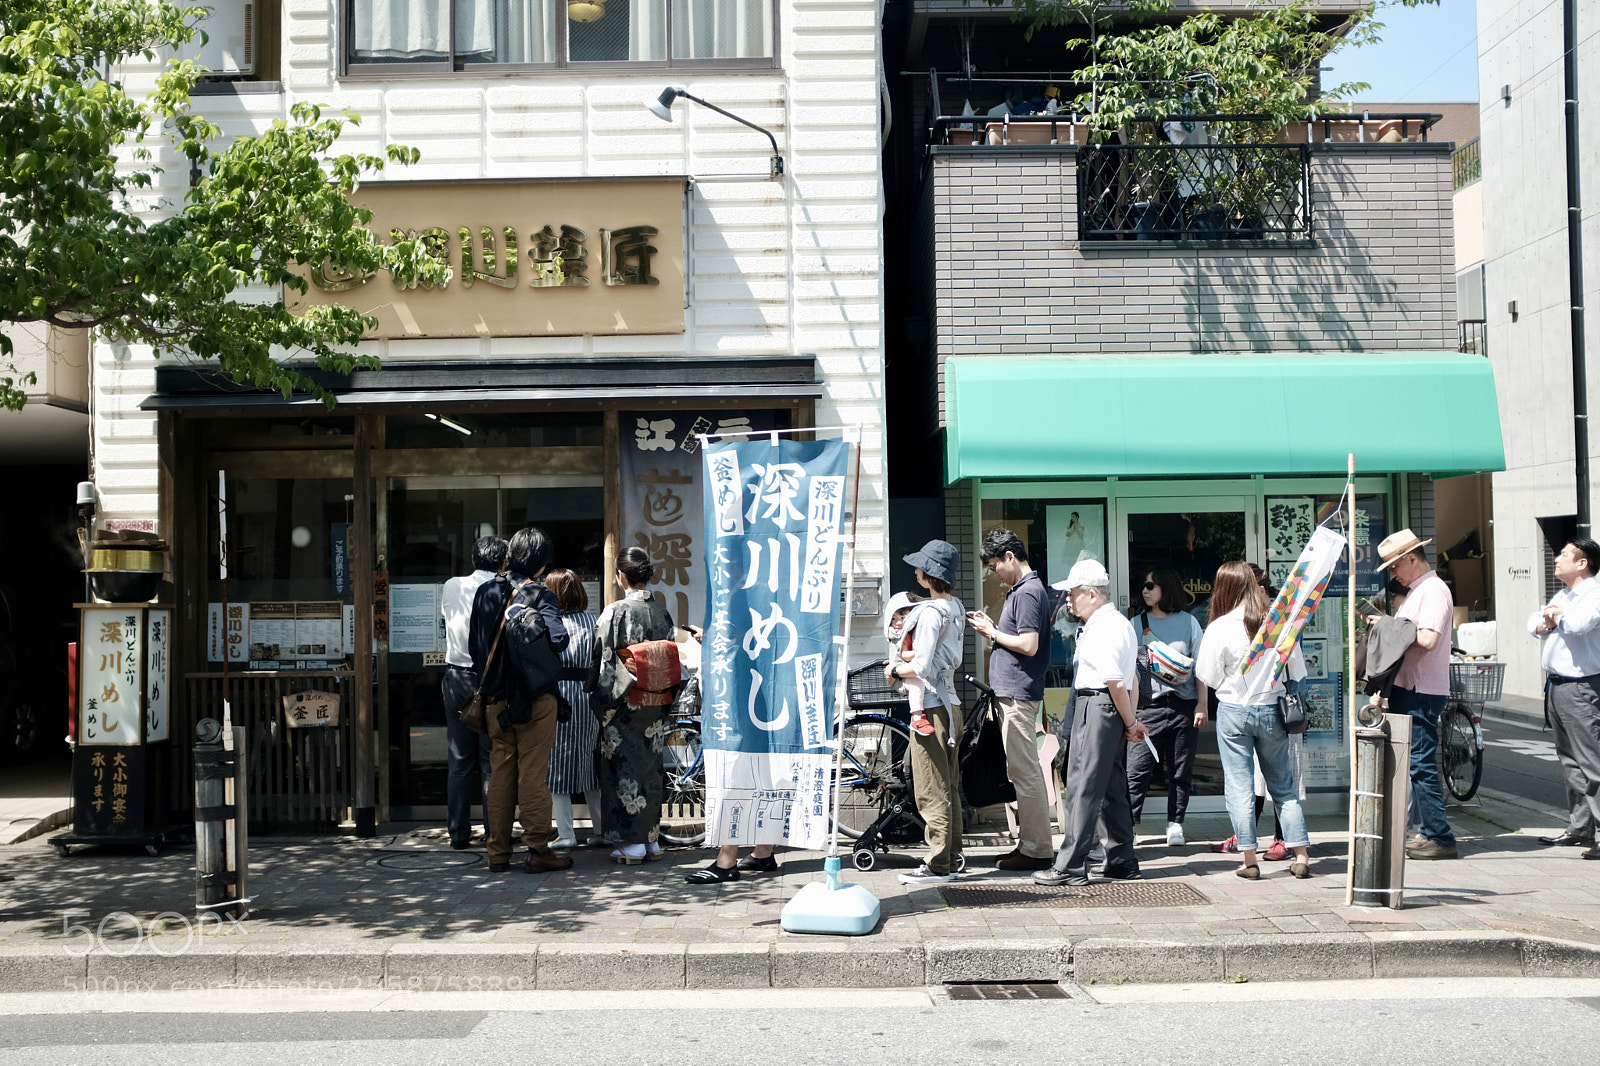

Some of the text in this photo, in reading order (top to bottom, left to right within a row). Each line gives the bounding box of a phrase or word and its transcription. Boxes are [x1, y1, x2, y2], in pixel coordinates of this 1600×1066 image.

[713, 456, 737, 533] 釜めし
[807, 480, 838, 610] 深川どんぶり
[742, 462, 807, 731] 深川めし
[99, 621, 123, 734] 深川めし
[125, 615, 137, 687] 深川どんぶり
[711, 543, 734, 741] 大小ご宴会承ります
[87, 698, 98, 740] 釜めし
[294, 705, 329, 720] 釜匠
[91, 752, 106, 813] 承ります
[812, 766, 825, 817] 清澄庭園
